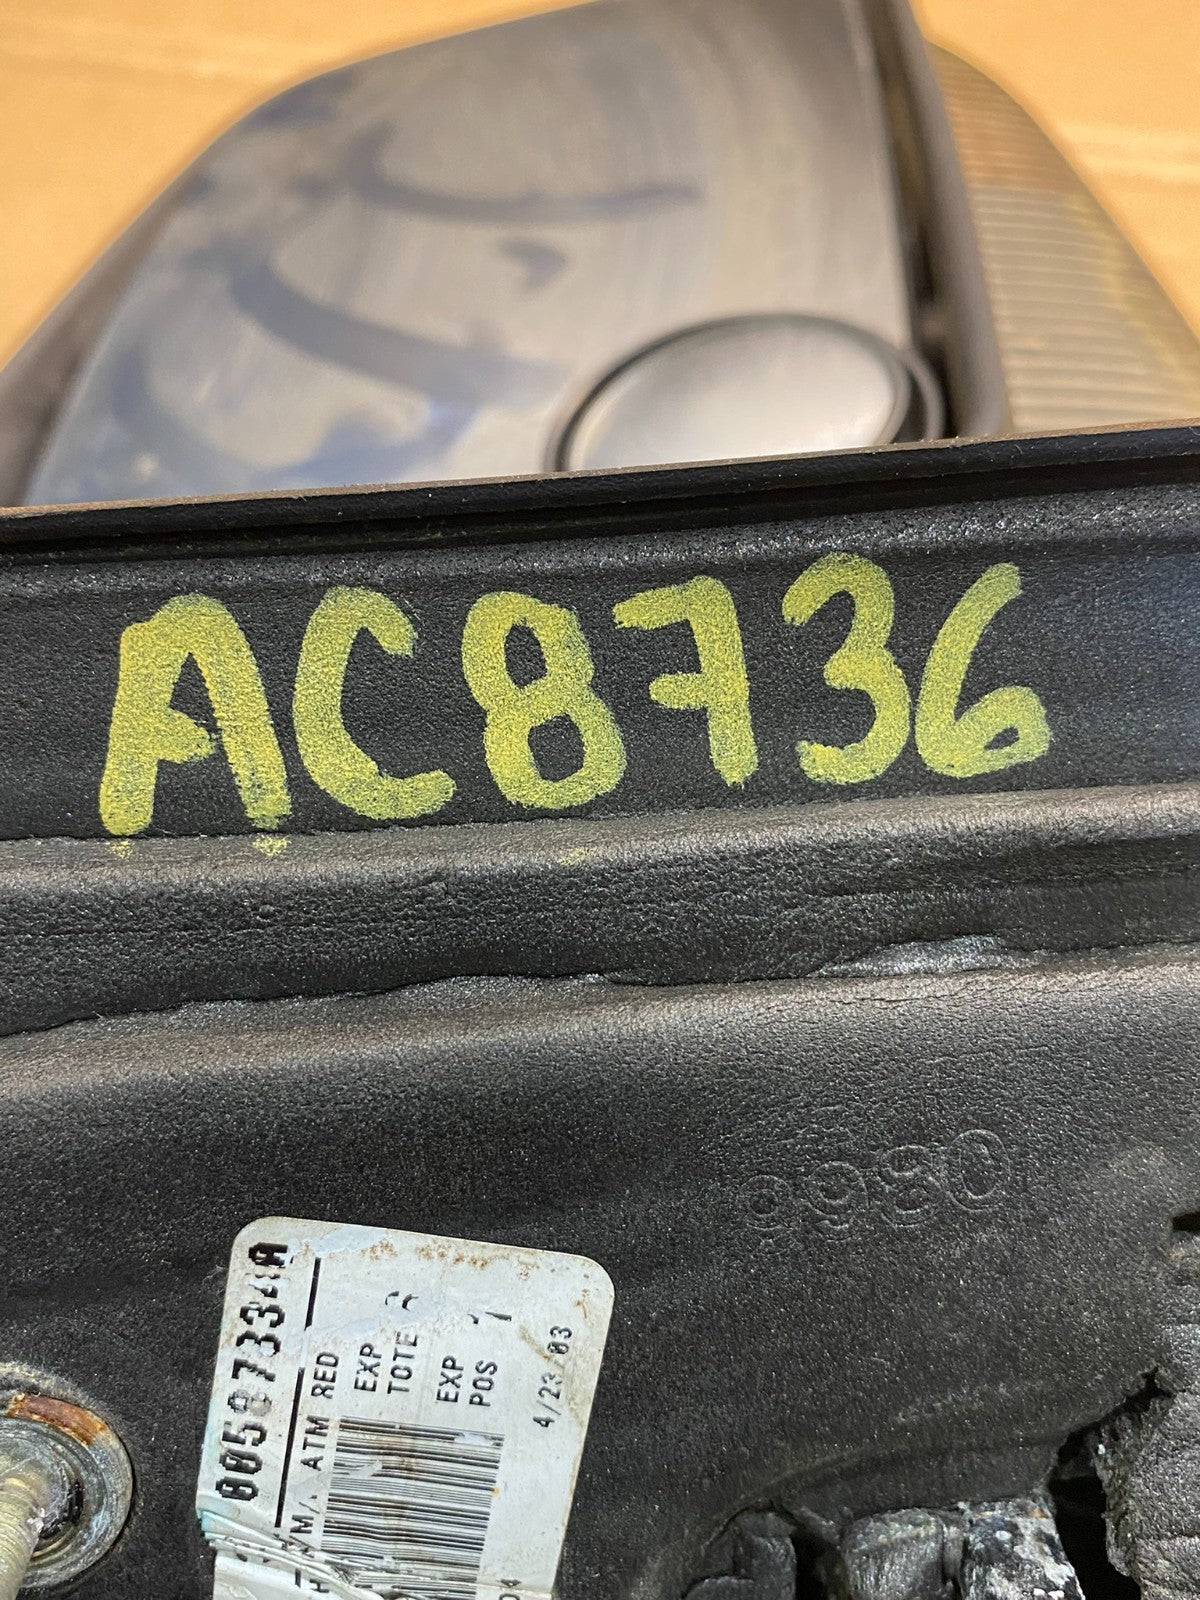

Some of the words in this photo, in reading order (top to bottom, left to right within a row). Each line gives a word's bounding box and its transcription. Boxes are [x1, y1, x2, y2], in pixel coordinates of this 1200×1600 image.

[100, 552, 1051, 838] AC8736
[310, 1352, 340, 1399] RED
[354, 1341, 382, 1393] EXP
[387, 1331, 418, 1394] TOTE
[436, 1355, 464, 1403] EXP
[469, 1359, 498, 1406] POS
[300, 1415, 330, 1472] ATM
